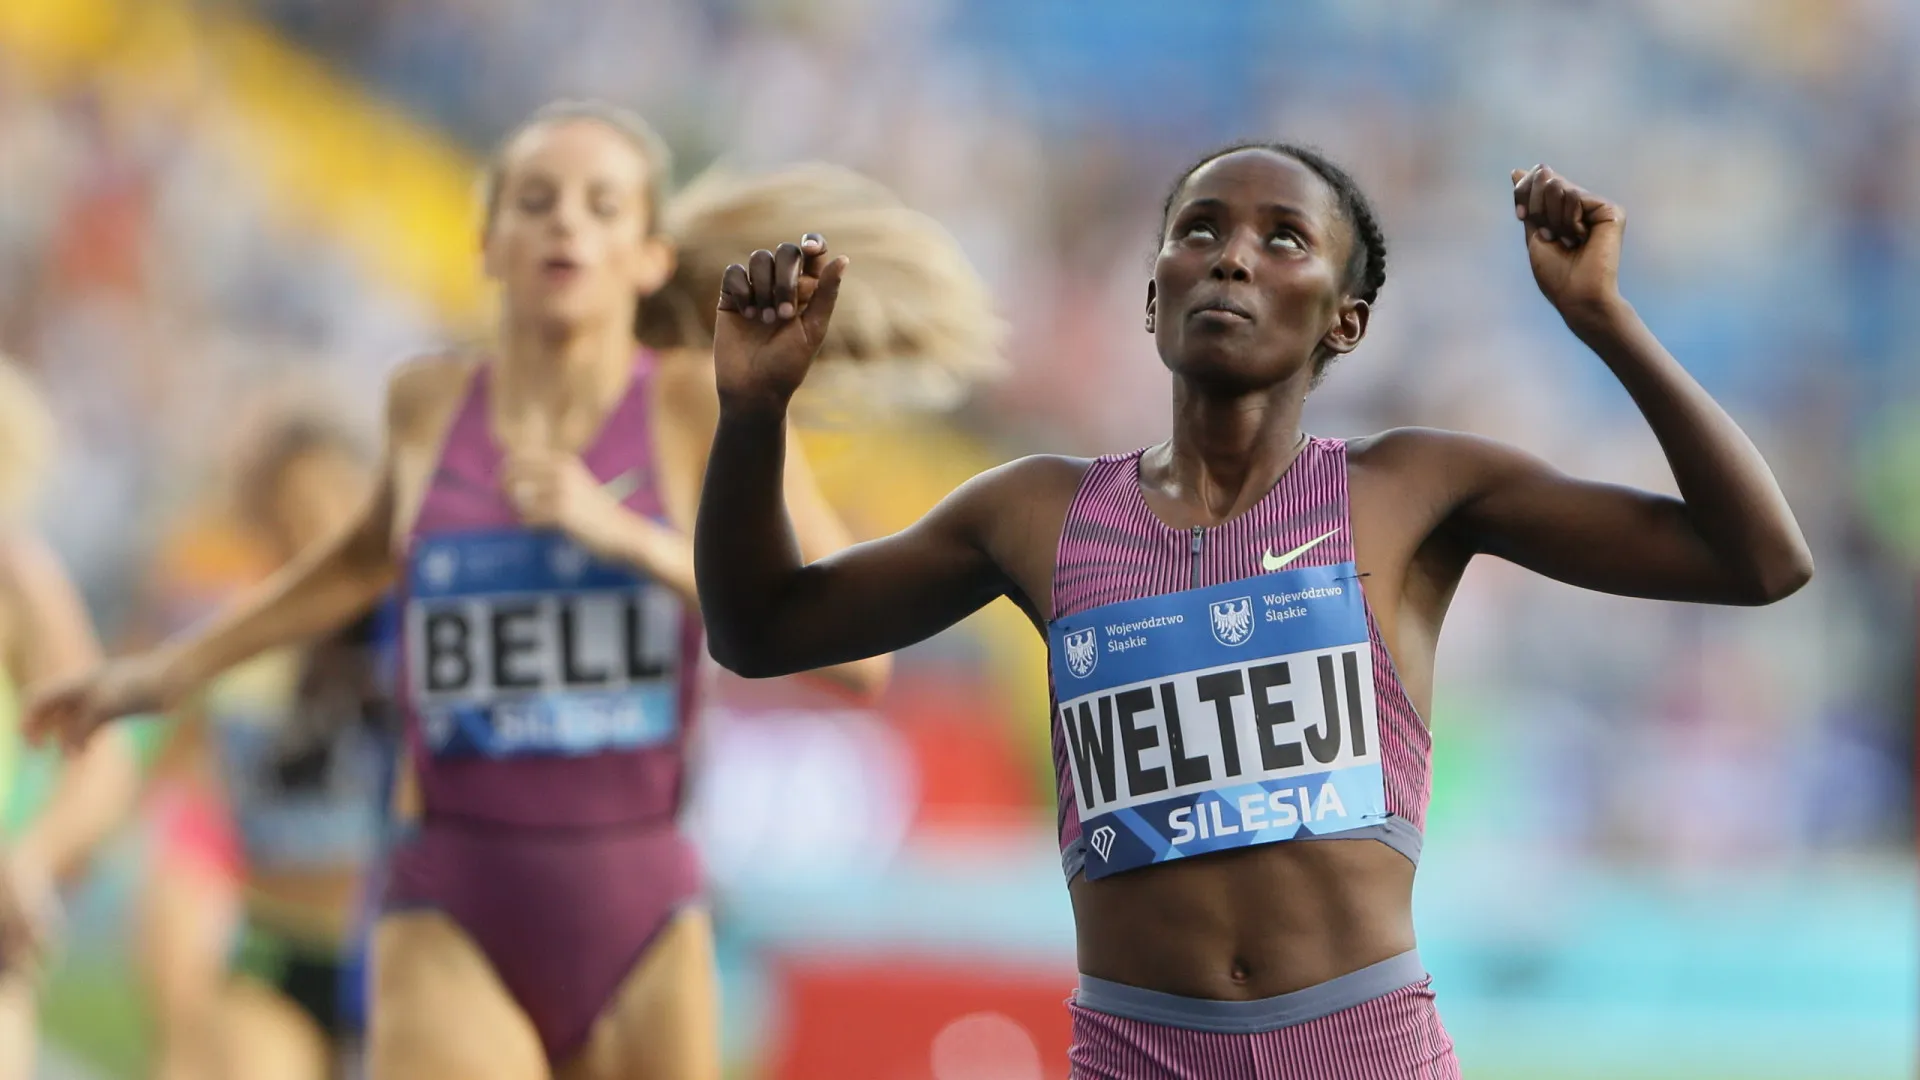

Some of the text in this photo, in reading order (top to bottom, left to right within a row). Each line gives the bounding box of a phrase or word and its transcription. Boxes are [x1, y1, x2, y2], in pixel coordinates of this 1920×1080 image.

[1263, 585, 1342, 607] Województwo
[1105, 612, 1184, 637] Województwo
[1265, 605, 1308, 623] Śląskie
[424, 598, 666, 691] BELL
[1107, 635, 1147, 653] Śląskie
[1063, 651, 1367, 810] WELTEJI
[1168, 783, 1347, 845] SILESIA
